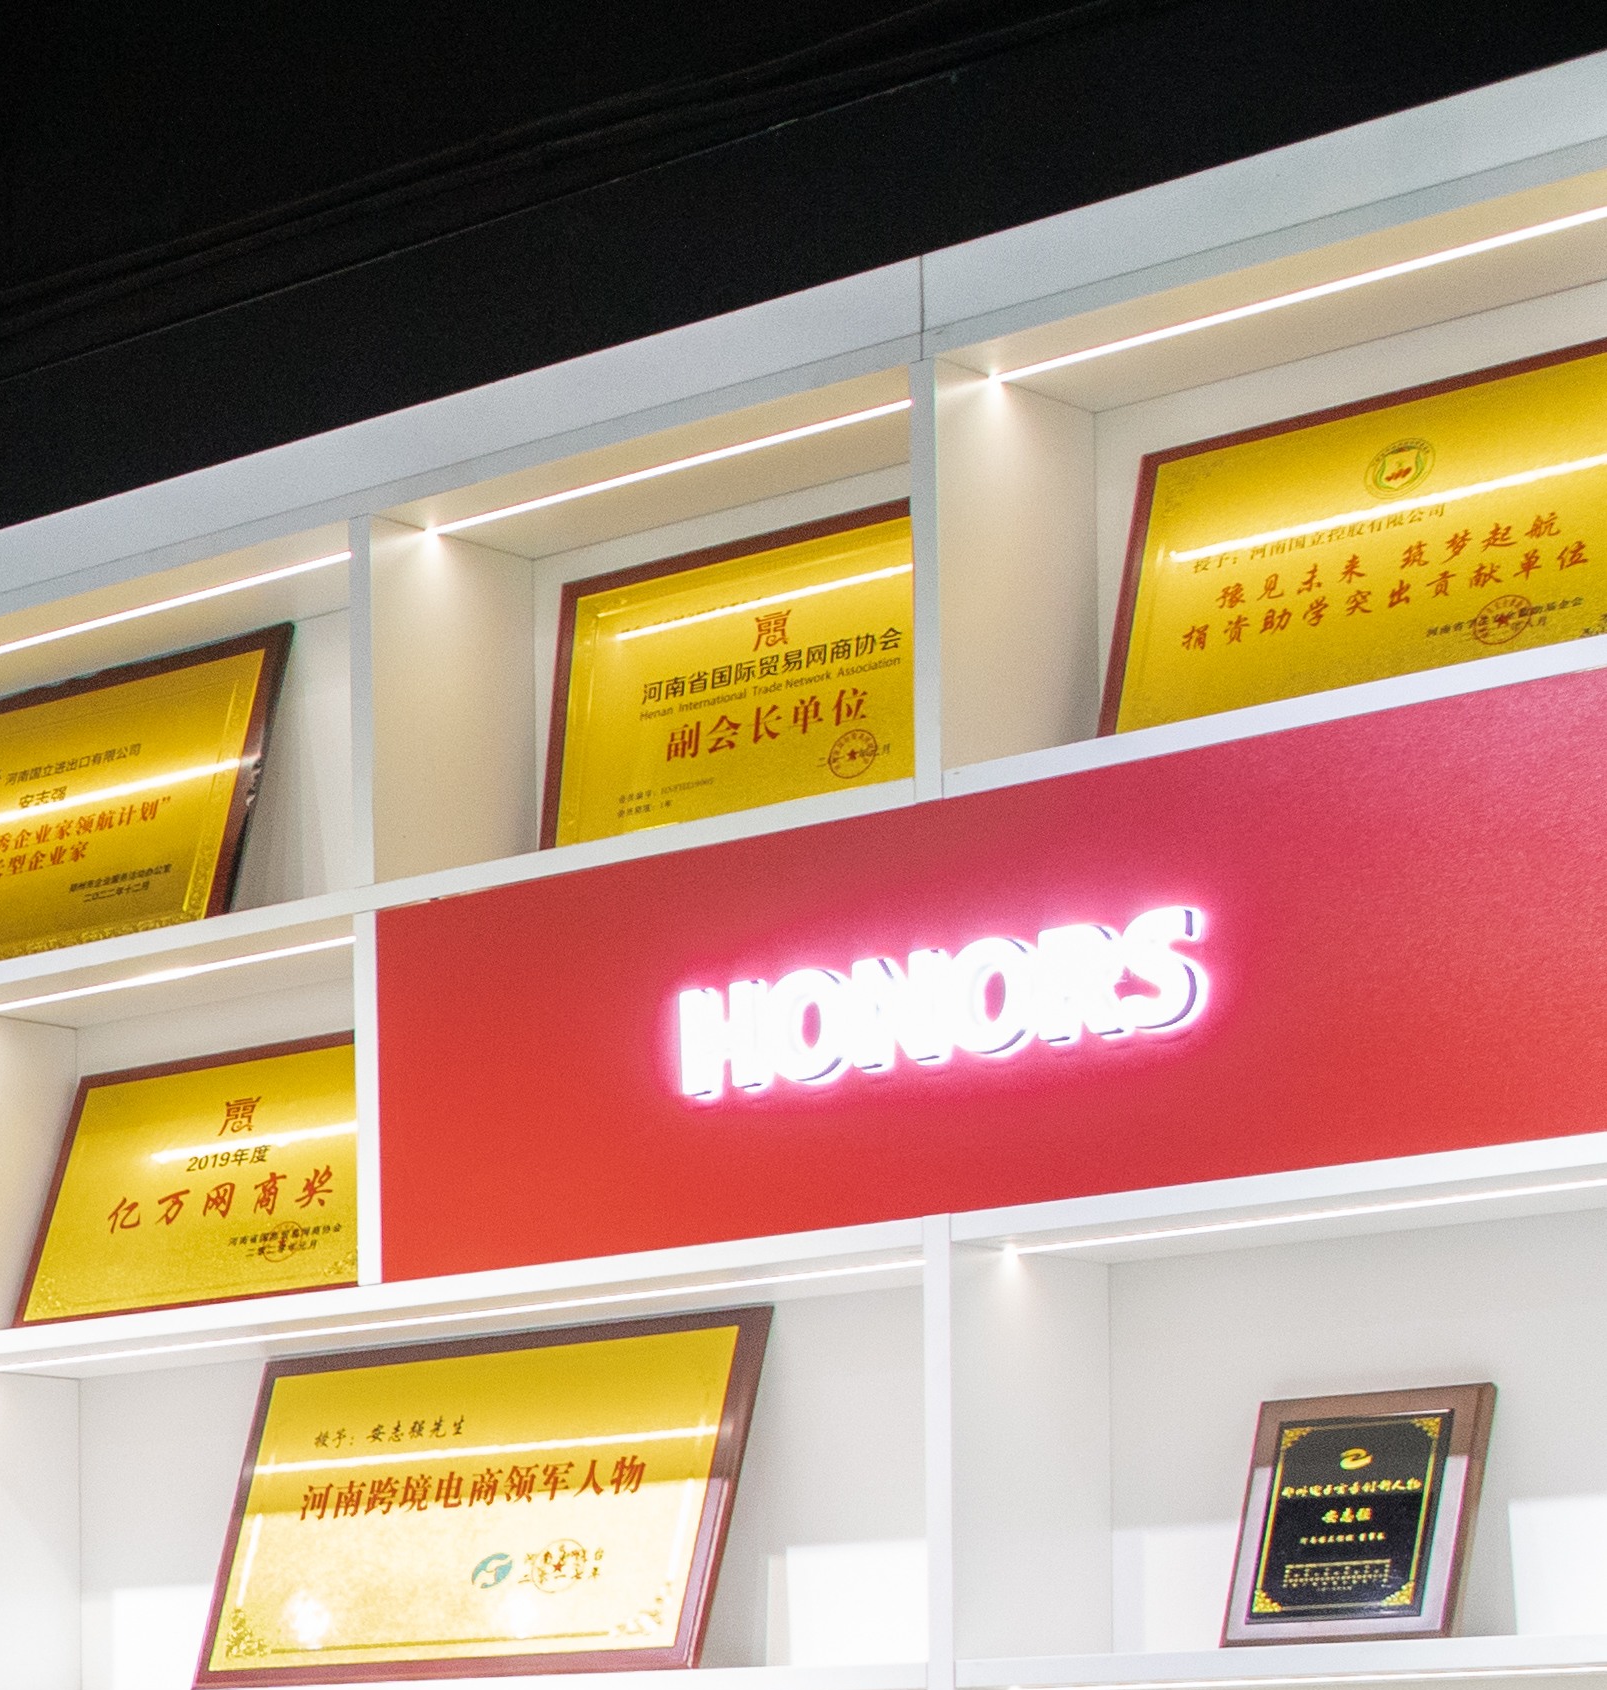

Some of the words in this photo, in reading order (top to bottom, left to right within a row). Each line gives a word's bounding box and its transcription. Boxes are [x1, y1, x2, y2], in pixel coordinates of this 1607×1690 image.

[1182, 541, 1590, 651] 捐资助学突出贡献单位
[639, 704, 674, 723] Henan
[678, 687, 747, 713] International
[752, 680, 784, 699] Trade
[785, 670, 832, 692] Network
[837, 655, 902, 679] Association
[642, 626, 903, 705] 河南省国际贸易网商协会
[666, 687, 868, 762] 副会长单位
[4, 743, 142, 787] 河南国立进出口有限公司
[679, 905, 1208, 1100] HONORS
[186, 1144, 272, 1172] 2019年度
[107, 1165, 334, 1235] 亿万网商奖
[298, 1454, 647, 1522] 河南跨境电商领军人物
